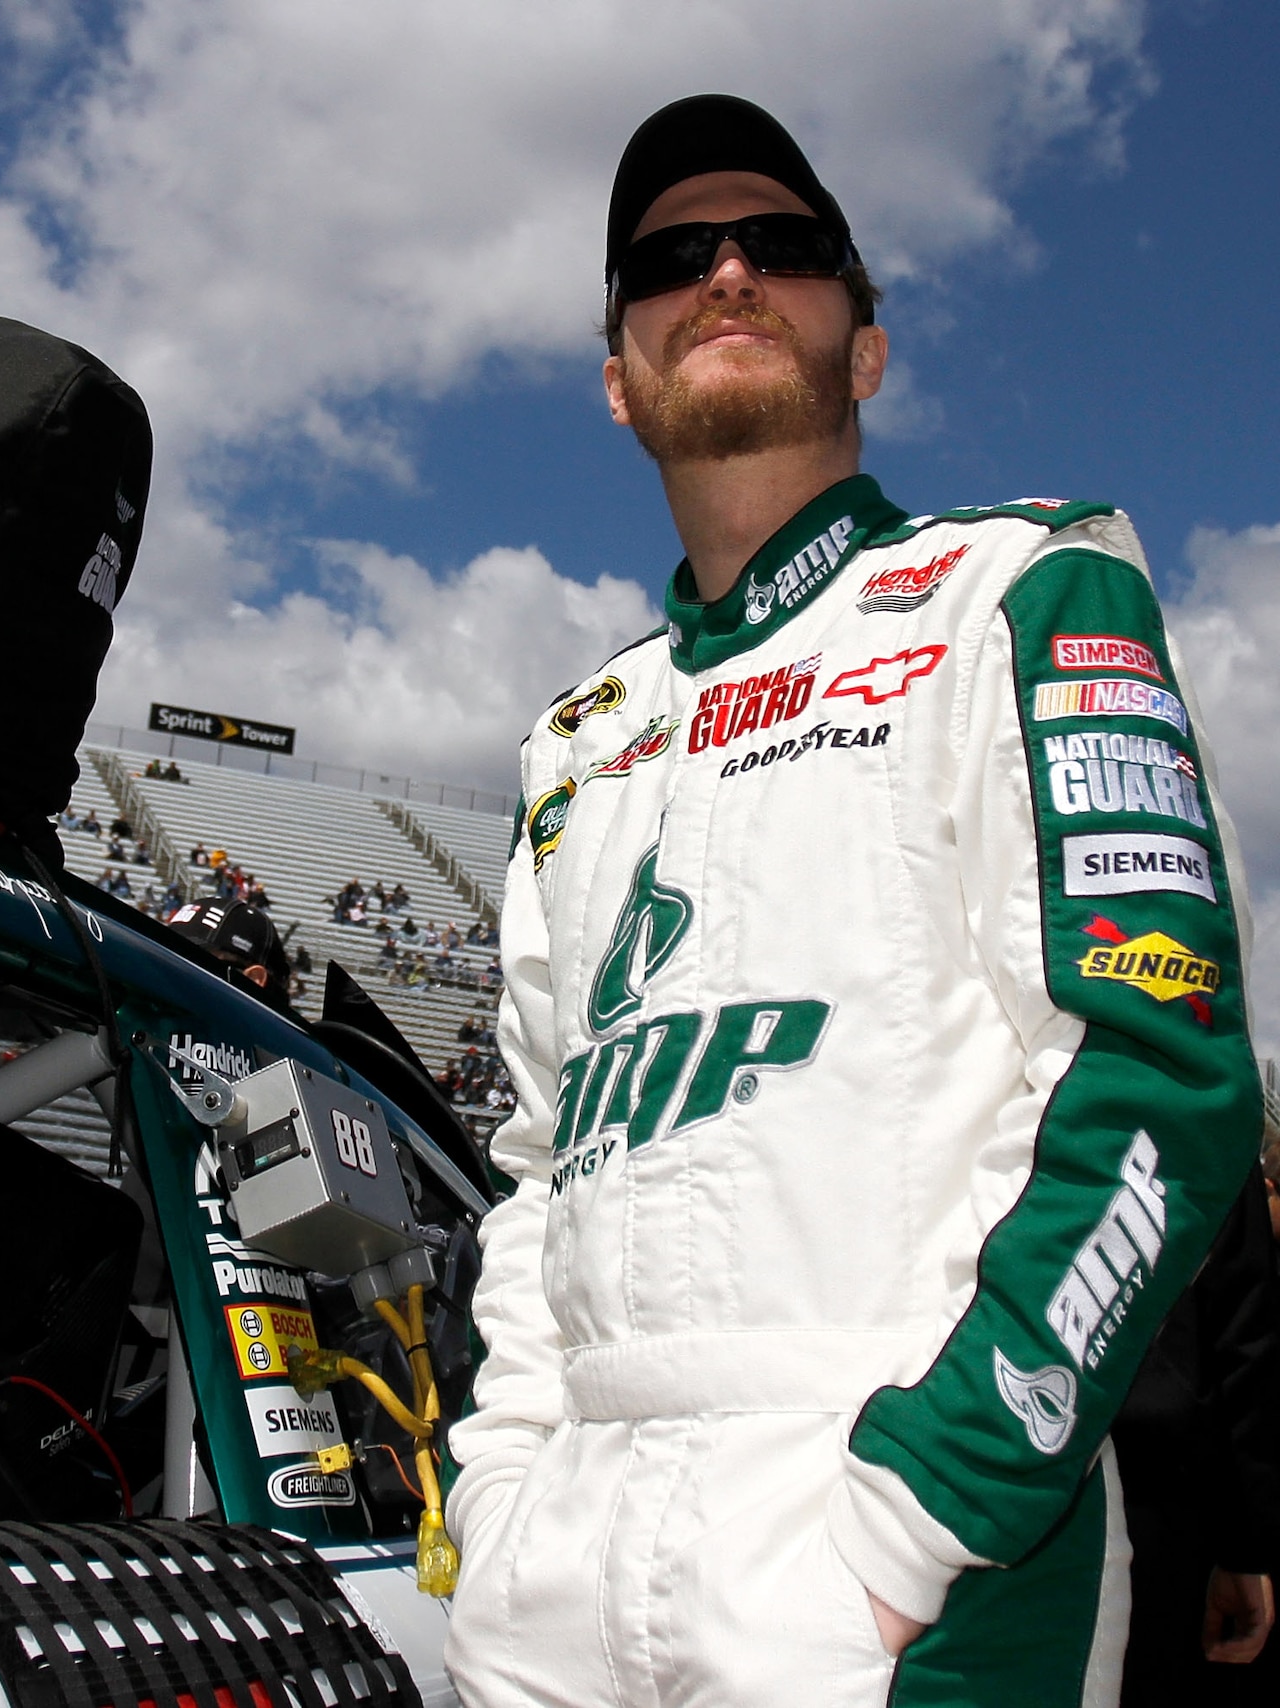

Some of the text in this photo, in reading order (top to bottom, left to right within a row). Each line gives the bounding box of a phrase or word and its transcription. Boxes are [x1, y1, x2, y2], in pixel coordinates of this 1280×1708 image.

[785, 563, 829, 609] ENERGY
[1062, 641, 1160, 675] SIMPSON
[697, 663, 796, 713] NATIONAL
[158, 708, 289, 746] Sprint Tower
[687, 674, 816, 755] GUARD
[720, 720, 891, 779] GOODYEAR
[1043, 732, 1178, 770] NATIONAL
[1049, 759, 1208, 829] GUARD
[1084, 851, 1204, 880] SIEMENS
[1088, 951, 1220, 989] SUNOCO
[168, 1034, 250, 1079] Hendrick
[331, 1108, 377, 1178] 88
[212, 1260, 307, 1300] Purolator
[271, 1313, 313, 1340] BOSCH
[1087, 1268, 1146, 1371] ENERGY
[265, 1408, 335, 1433] SIEMENS
[288, 1475, 348, 1495] FREIGHTLINER
